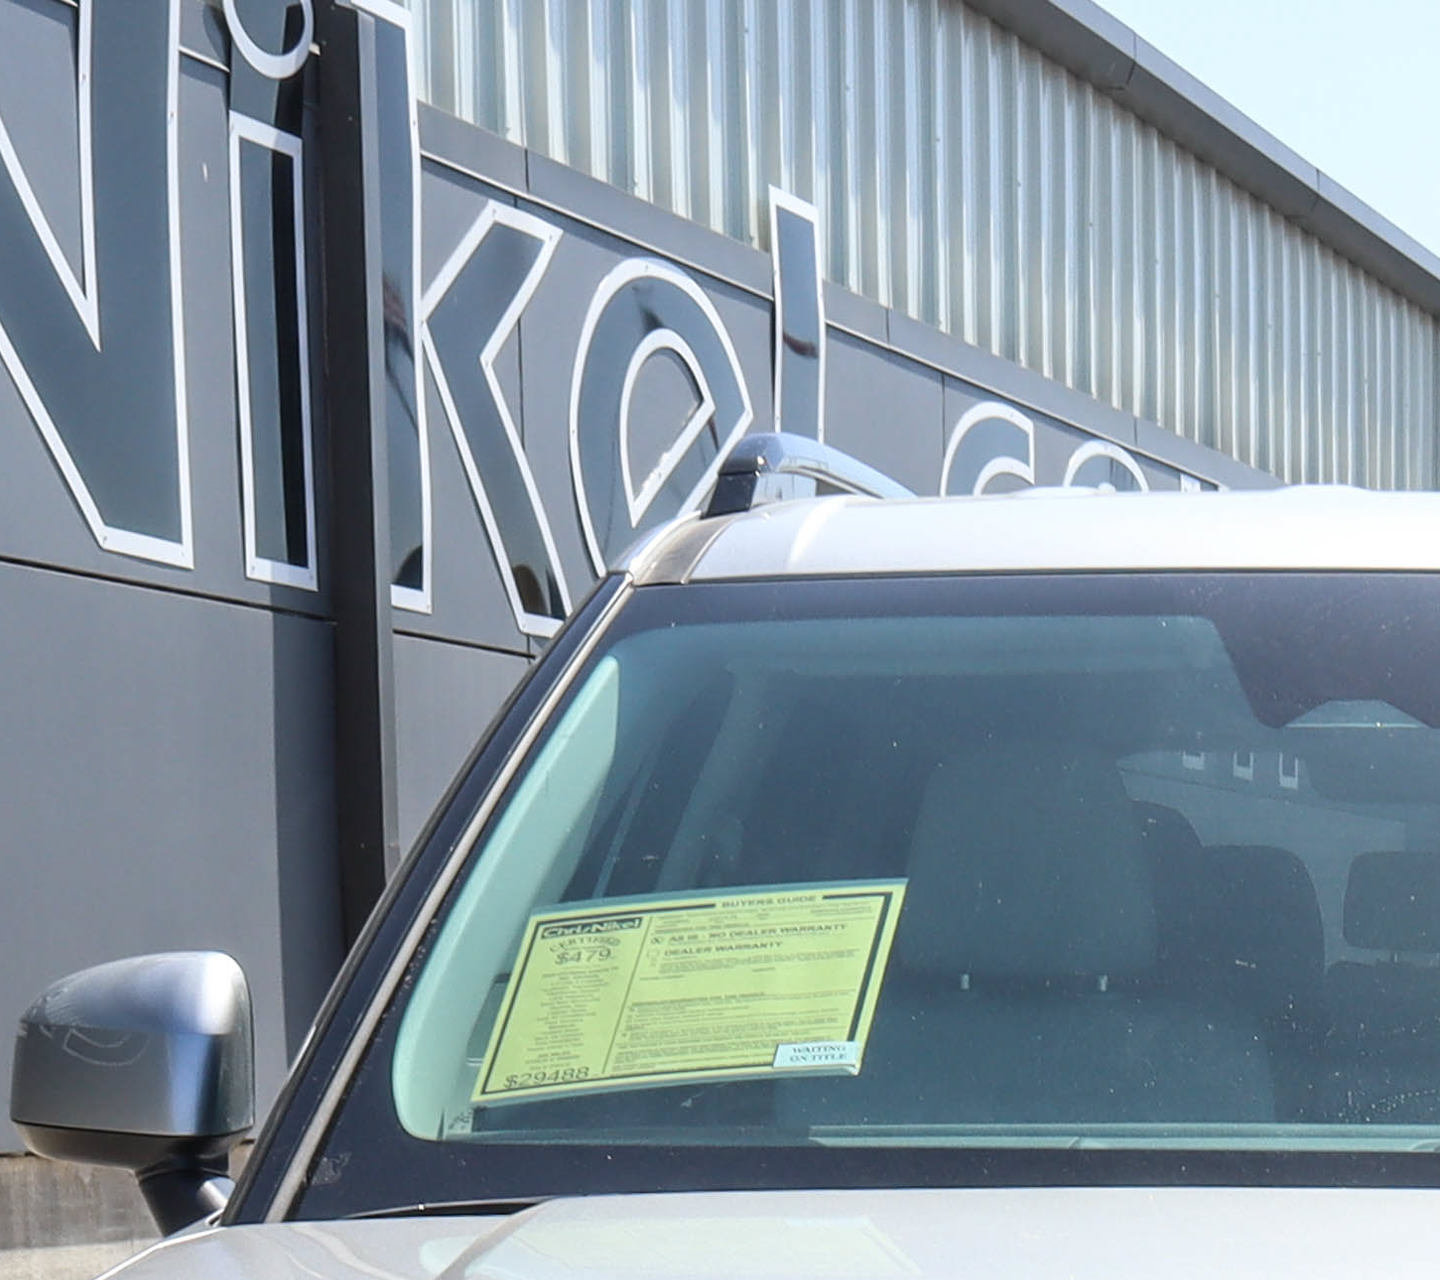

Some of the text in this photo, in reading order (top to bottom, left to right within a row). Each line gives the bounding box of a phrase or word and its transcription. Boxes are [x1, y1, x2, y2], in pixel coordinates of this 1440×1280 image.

[729, 928, 777, 937] DEALER
[780, 923, 848, 934] WARRANTY
[664, 941, 784, 957] DEALER WARRANTY
[555, 949, 611, 965] $479
[792, 1045, 847, 1054] WAITING
[812, 1053, 846, 1061] TITLE
[504, 1066, 590, 1089] $29488
